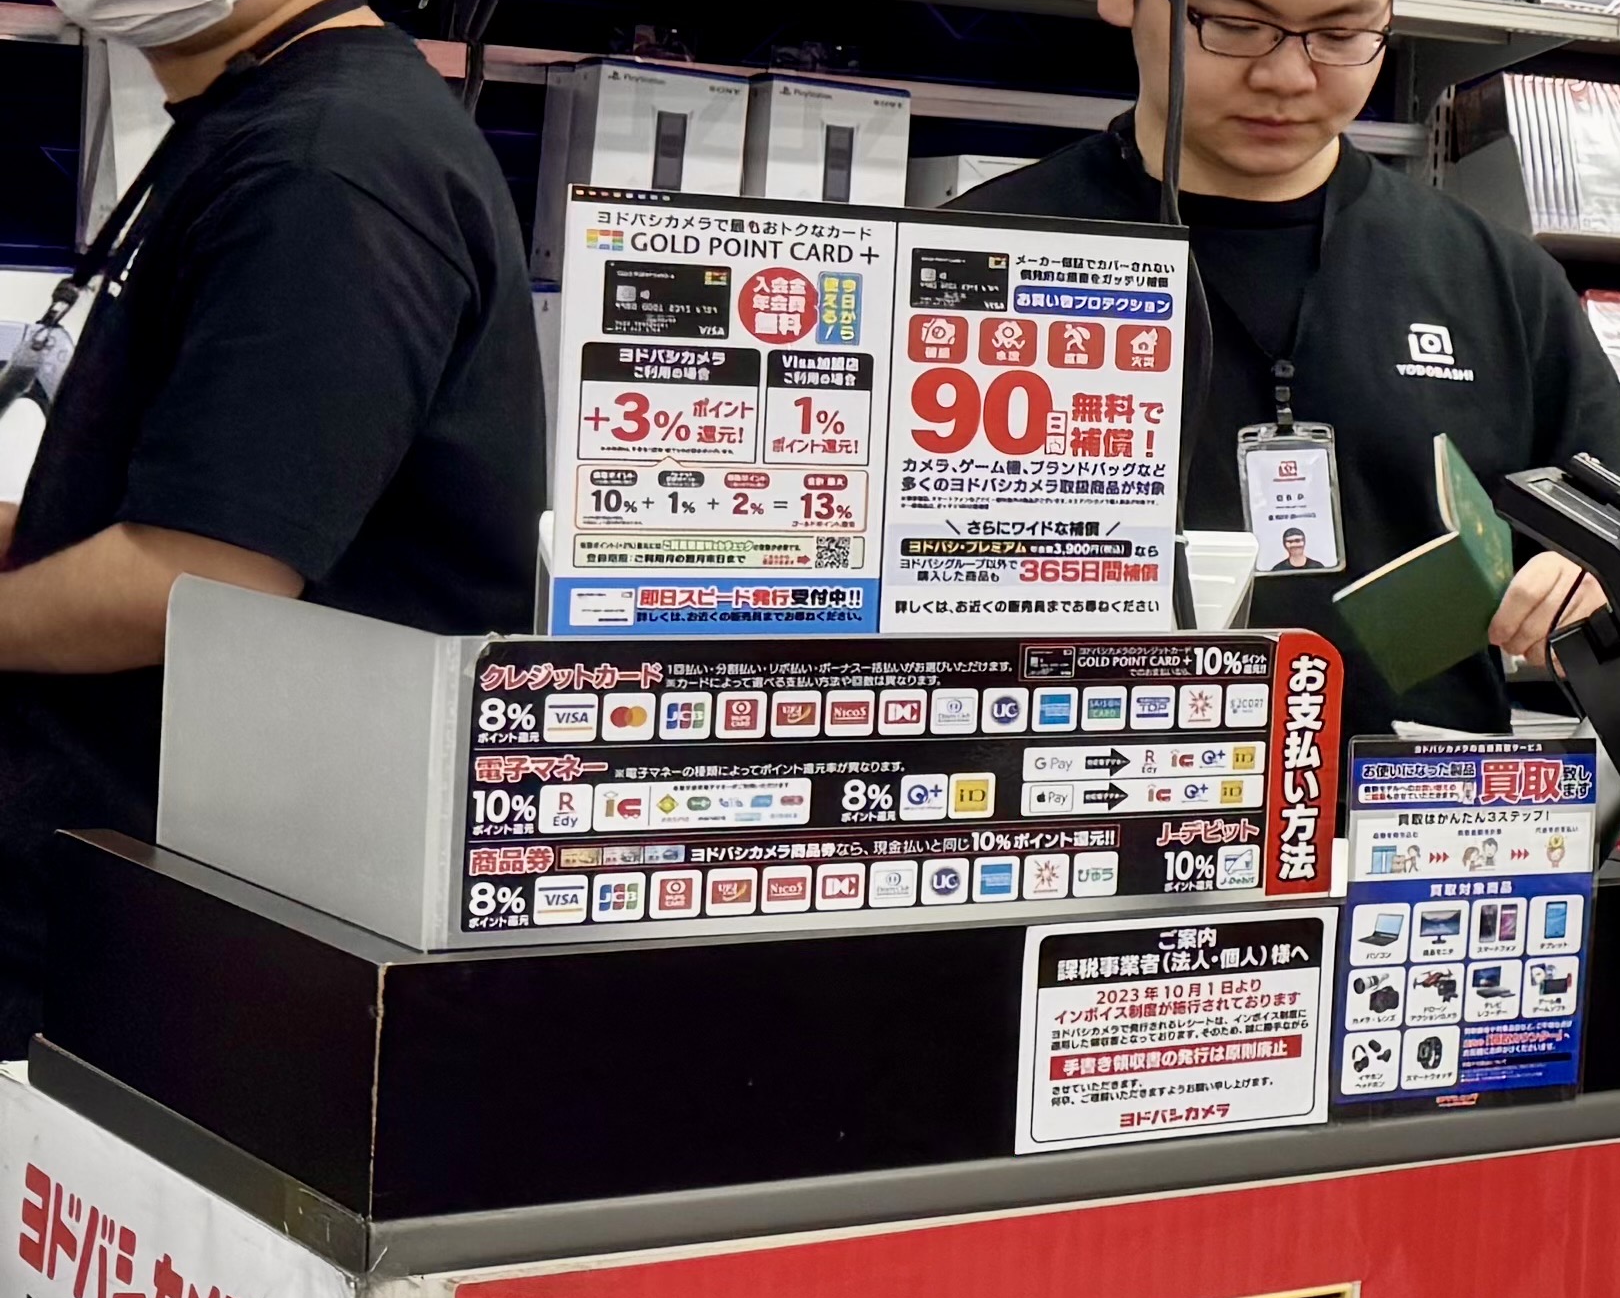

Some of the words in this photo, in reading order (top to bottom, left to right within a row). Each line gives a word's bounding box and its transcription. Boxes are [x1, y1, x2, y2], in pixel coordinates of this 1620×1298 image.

[630, 231, 701, 256] GOLD
[708, 236, 784, 261] POINT
[789, 241, 854, 264] CARD
[1395, 363, 1475, 382] YODOBASHI
[583, 391, 691, 443] +3%
[1070, 392, 1166, 425] 無料で
[479, 661, 664, 692] クレジットカード
[478, 697, 537, 732] 8%
[554, 710, 589, 725] VISA
[474, 754, 609, 784] 電子マネー
[1276, 654, 1328, 882] お支払い方法
[1480, 758, 1565, 805] 買取
[471, 788, 537, 824] 10%
[468, 846, 556, 877] 商品券
[1157, 926, 1217, 952] ご案内
[1119, 1103, 1232, 1129] ヨドバシカメラ
